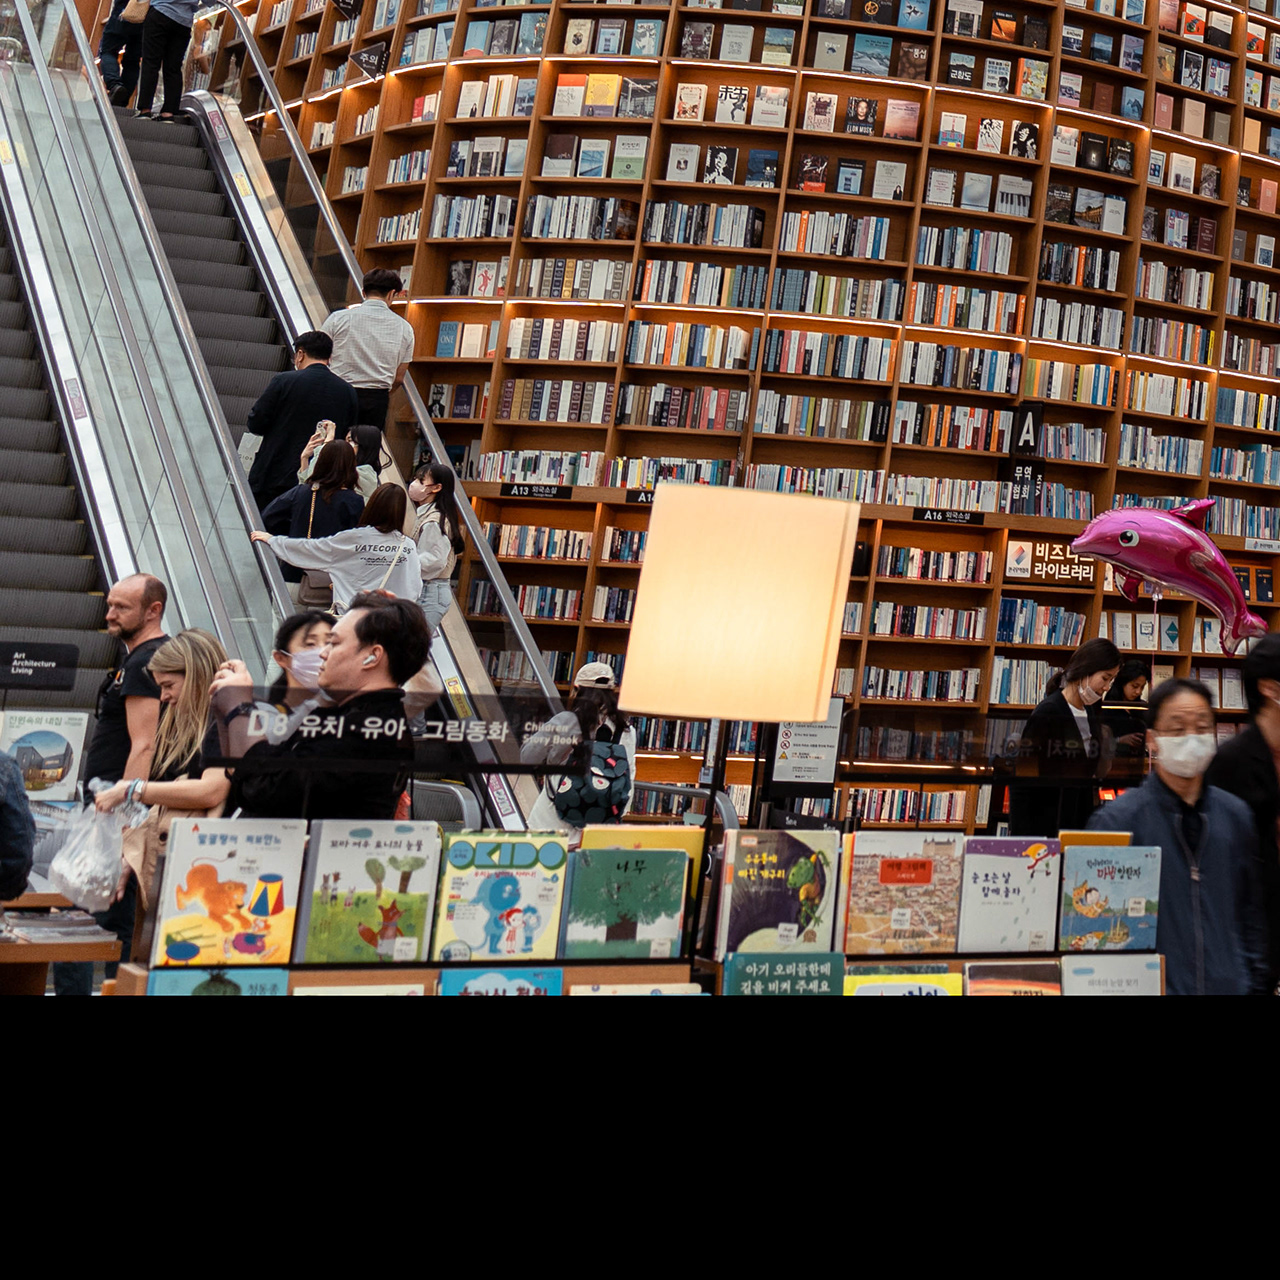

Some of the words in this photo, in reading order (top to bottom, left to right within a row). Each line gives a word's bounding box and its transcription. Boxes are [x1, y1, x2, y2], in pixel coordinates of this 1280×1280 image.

[360, 52, 378, 65] 주의
[1018, 415, 1035, 446] A
[511, 485, 529, 496] A13
[924, 510, 942, 520] A16
[1034, 562, 1094, 581] 라이브러리
[13, 652, 26, 660] Art
[12, 660, 57, 668] Architecture
[11, 667, 33, 676] Living
[299, 717, 344, 739] 유치
[361, 717, 406, 740] 유아
[422, 720, 509, 743] 그림동화
[449, 840, 568, 870] OKIDO
[746, 962, 769, 976] 아기
[773, 962, 831, 977] 오리들한테
